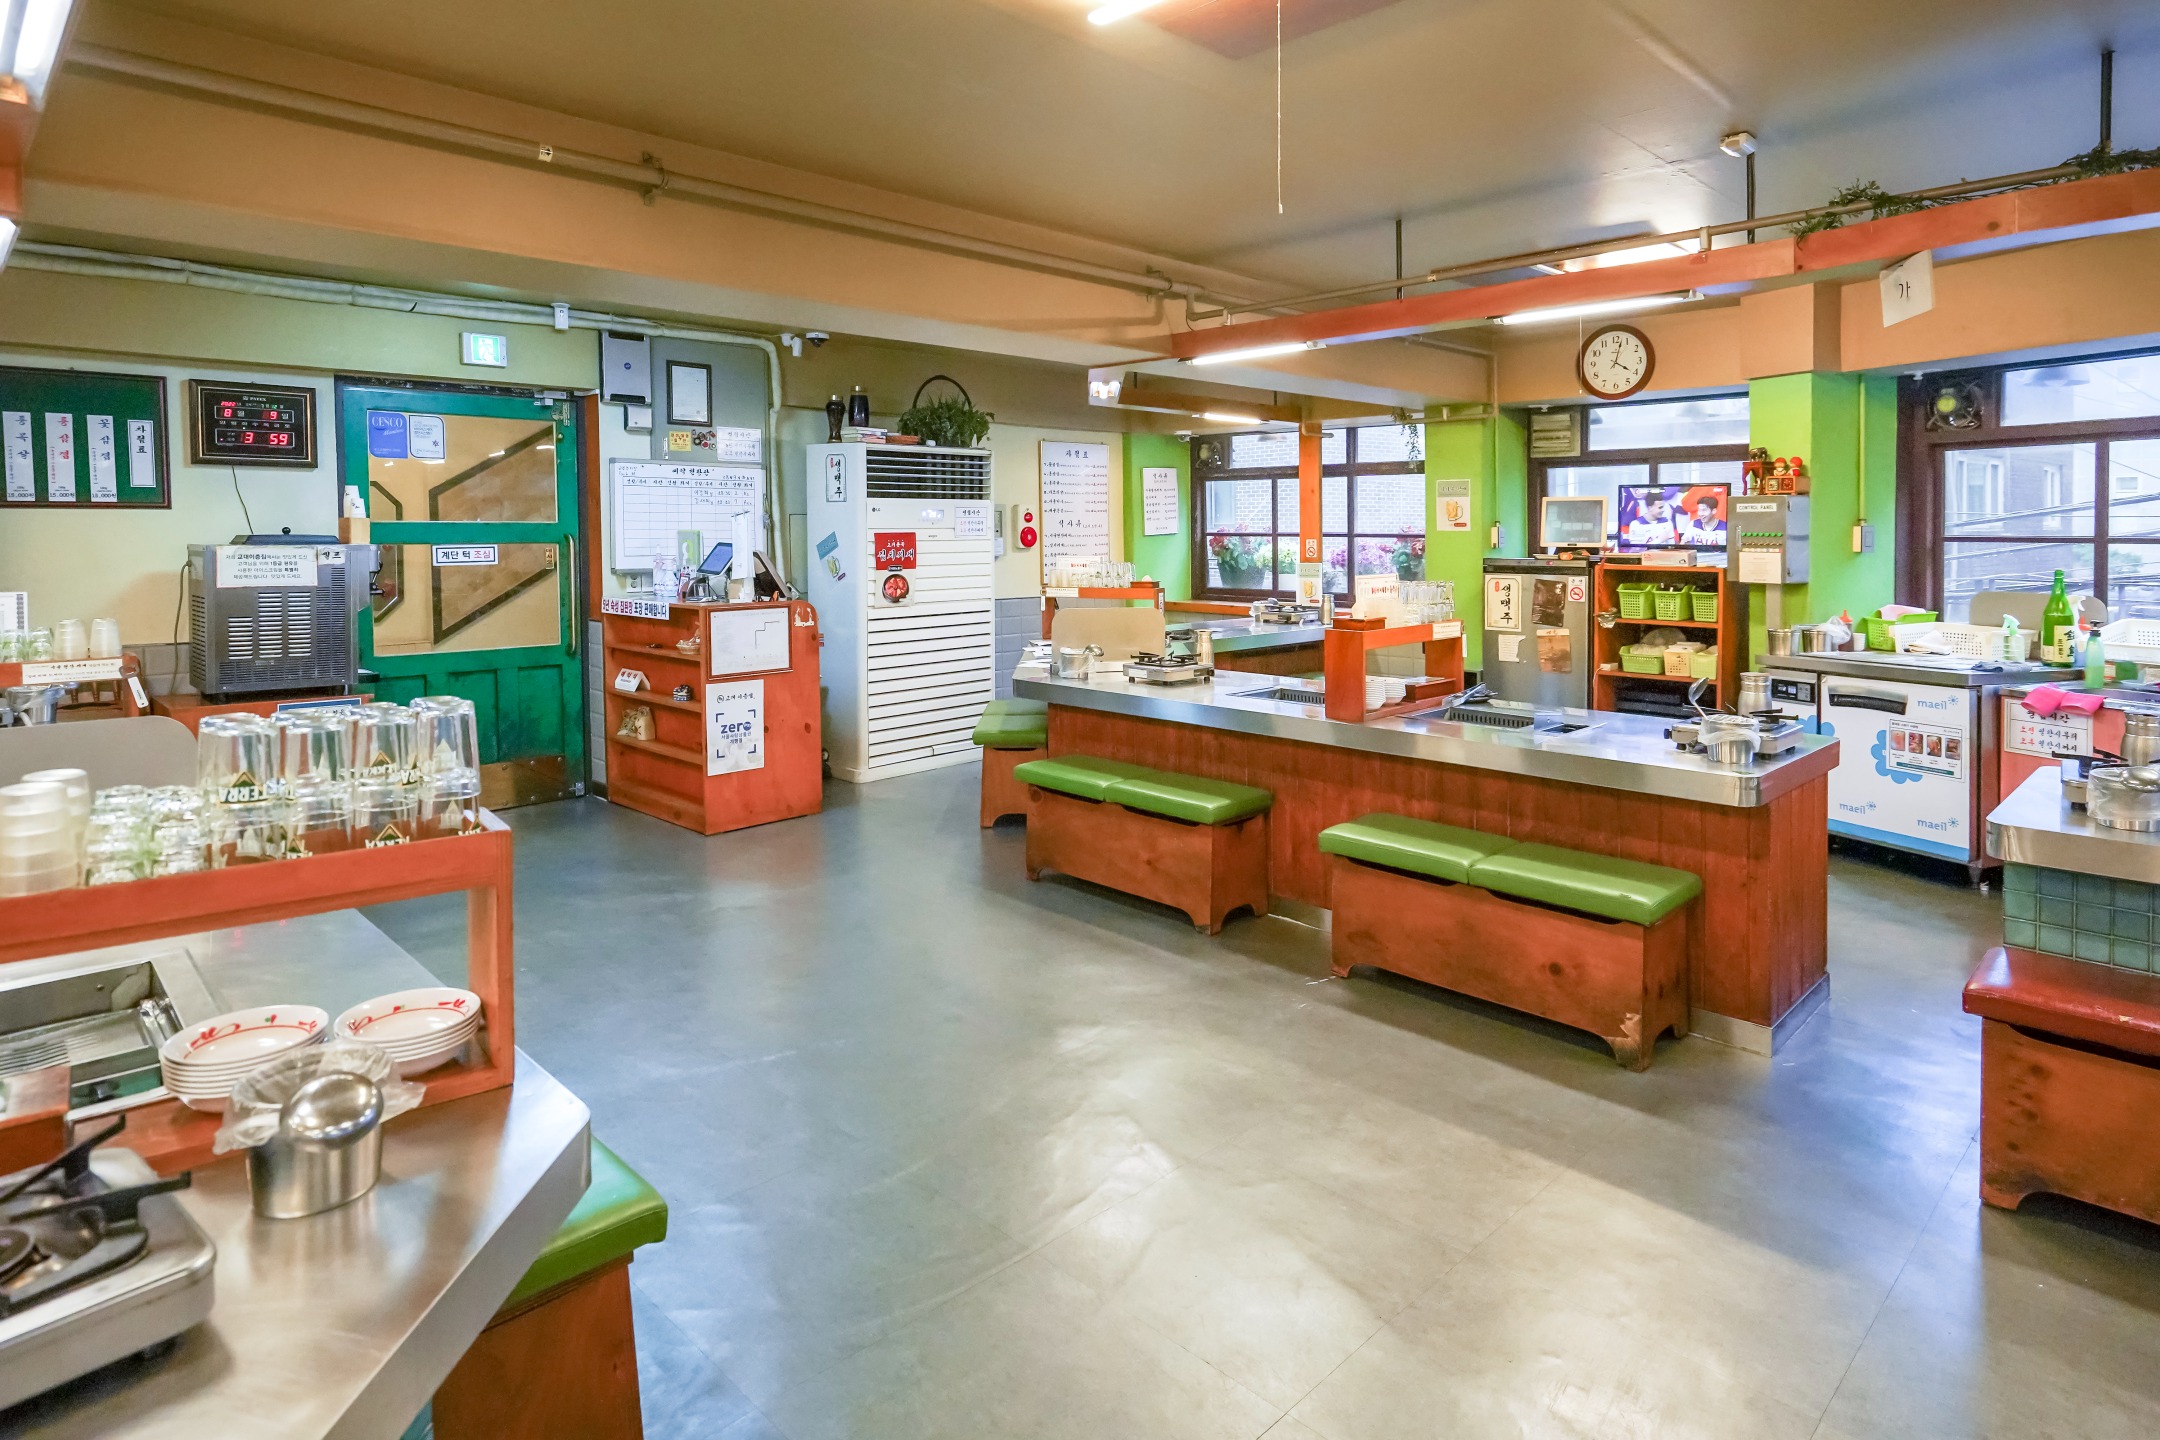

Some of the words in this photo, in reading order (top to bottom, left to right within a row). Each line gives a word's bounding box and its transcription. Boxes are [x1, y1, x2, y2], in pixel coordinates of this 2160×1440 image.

[1898, 281, 1910, 299] 가
[1601, 339, 1607, 348] 11
[224, 409, 232, 417] 8
[372, 416, 403, 428] CESCO
[98, 419, 111, 460] 꽃삼겹
[135, 425, 147, 453] 차림표
[244, 432, 254, 443] 3
[270, 433, 288, 445] 59
[442, 551, 459, 560] 계단
[462, 551, 471, 559] 턱
[474, 551, 491, 559] 조심
[877, 548, 914, 561] 김치찌개
[611, 600, 618, 612] 숙성
[621, 601, 633, 614] 집된장
[634, 602, 642, 615] 포장
[645, 603, 666, 617] 판매합니다
[1500, 583, 1512, 624] 생맥주
[1917, 699, 1947, 710] maeil
[721, 722, 751, 734] zero
[2020, 726, 2034, 734] 오전
[2038, 728, 2077, 740] 열한시부터
[2020, 738, 2035, 746] 오후
[2038, 740, 2077, 752] 열한시까지
[218, 786, 268, 803] TERRA
[1839, 802, 1865, 814] maeil
[1917, 818, 1947, 831] maeil
